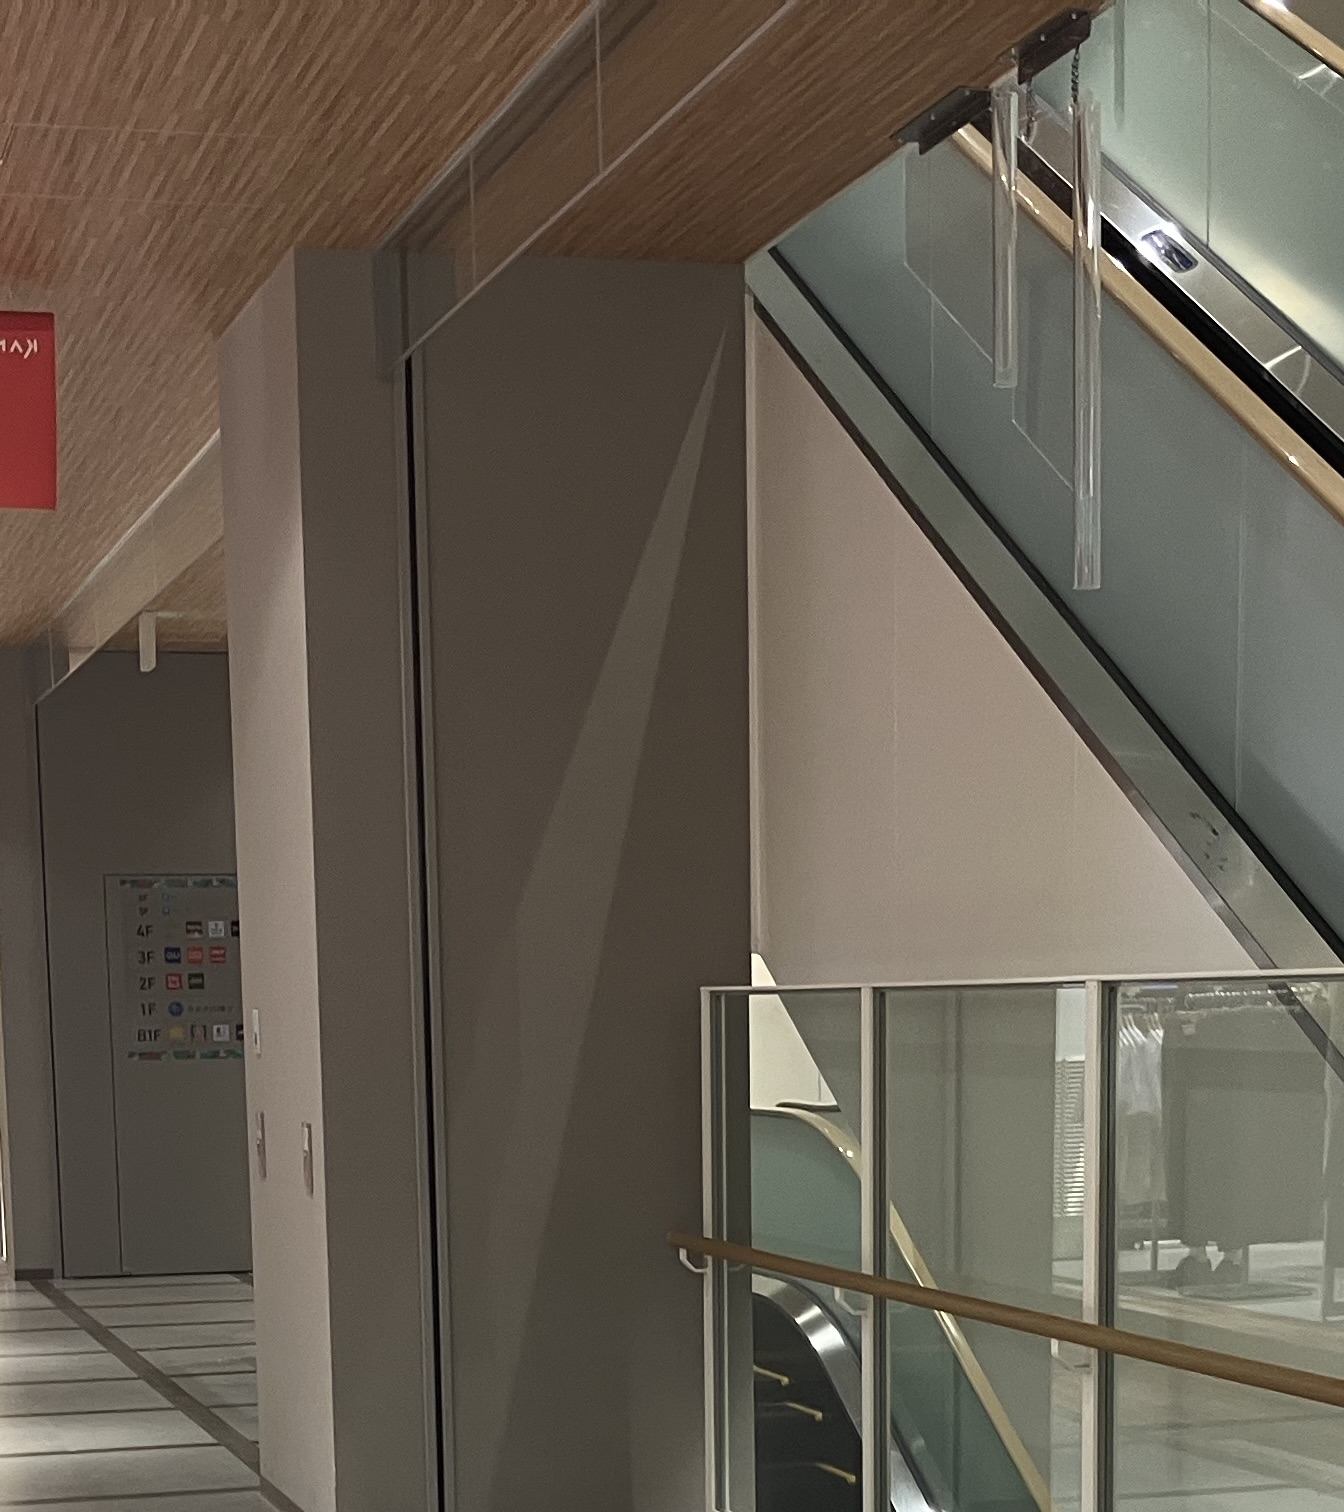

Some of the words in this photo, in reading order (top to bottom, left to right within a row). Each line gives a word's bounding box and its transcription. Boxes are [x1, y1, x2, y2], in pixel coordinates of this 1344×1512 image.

[136, 924, 154, 938] 4F
[138, 950, 155, 964] 3F
[139, 976, 156, 991] 2F
[141, 1002, 158, 1016] 1F
[137, 1028, 162, 1042] B1F
